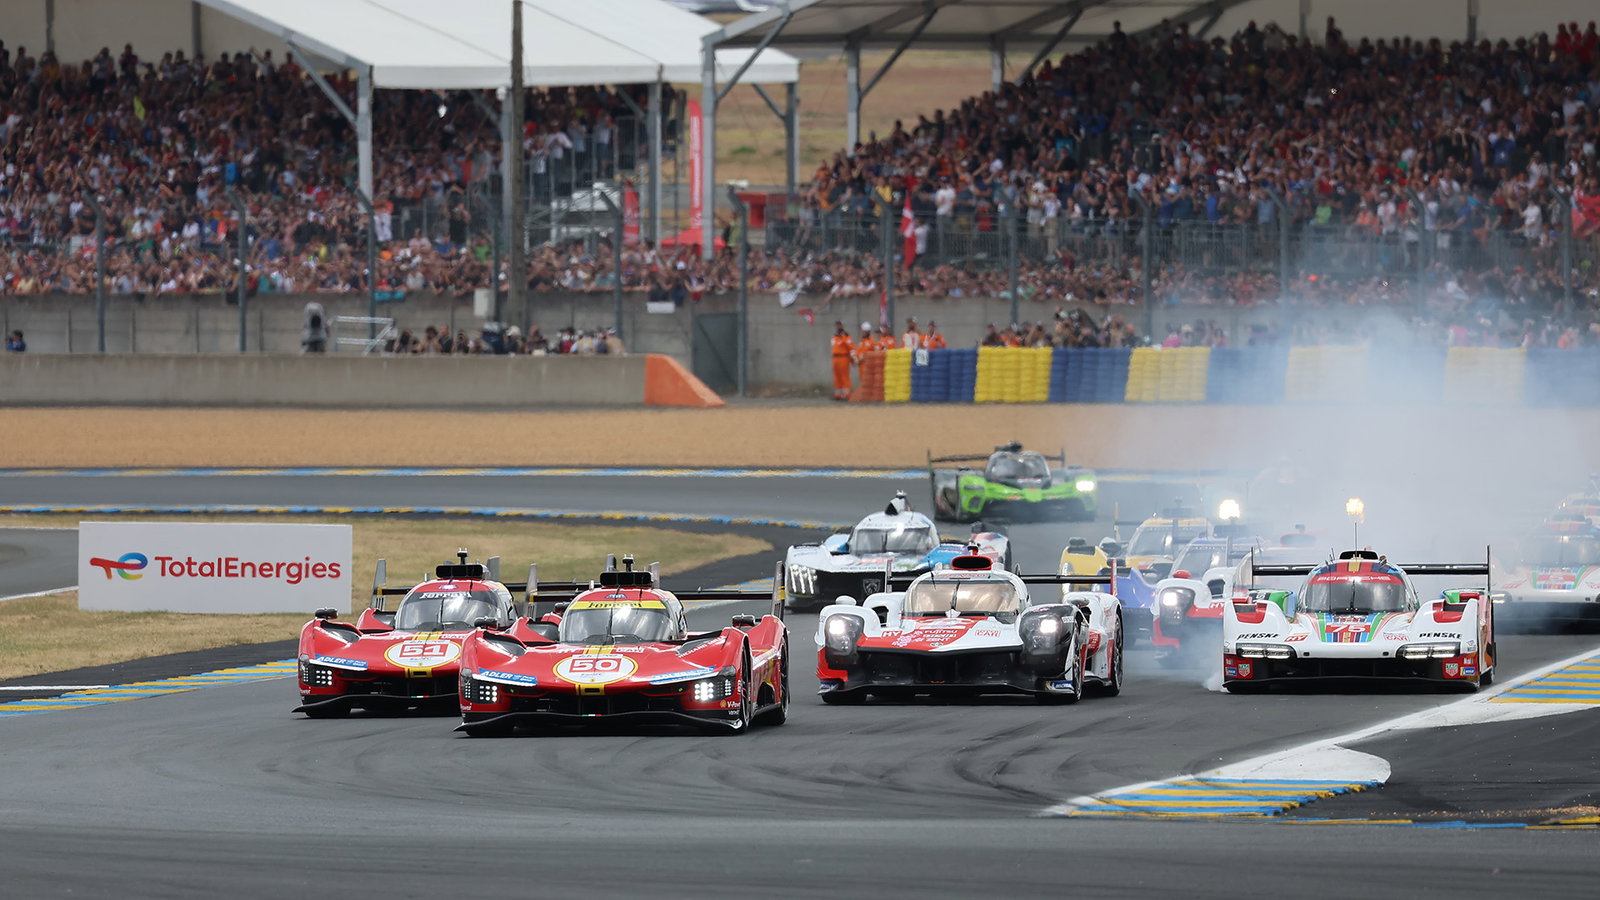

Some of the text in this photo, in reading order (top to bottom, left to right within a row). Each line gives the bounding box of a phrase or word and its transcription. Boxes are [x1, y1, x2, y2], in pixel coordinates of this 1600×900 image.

[154, 556, 341, 584] TotalEnergies
[420, 591, 472, 600] Ferrari
[588, 601, 642, 609] Ferrari
[1330, 624, 1367, 633] 75
[402, 644, 448, 657] 51
[317, 656, 346, 665] ADLER
[571, 659, 619, 672] 50
[481, 670, 514, 680] ADLER
